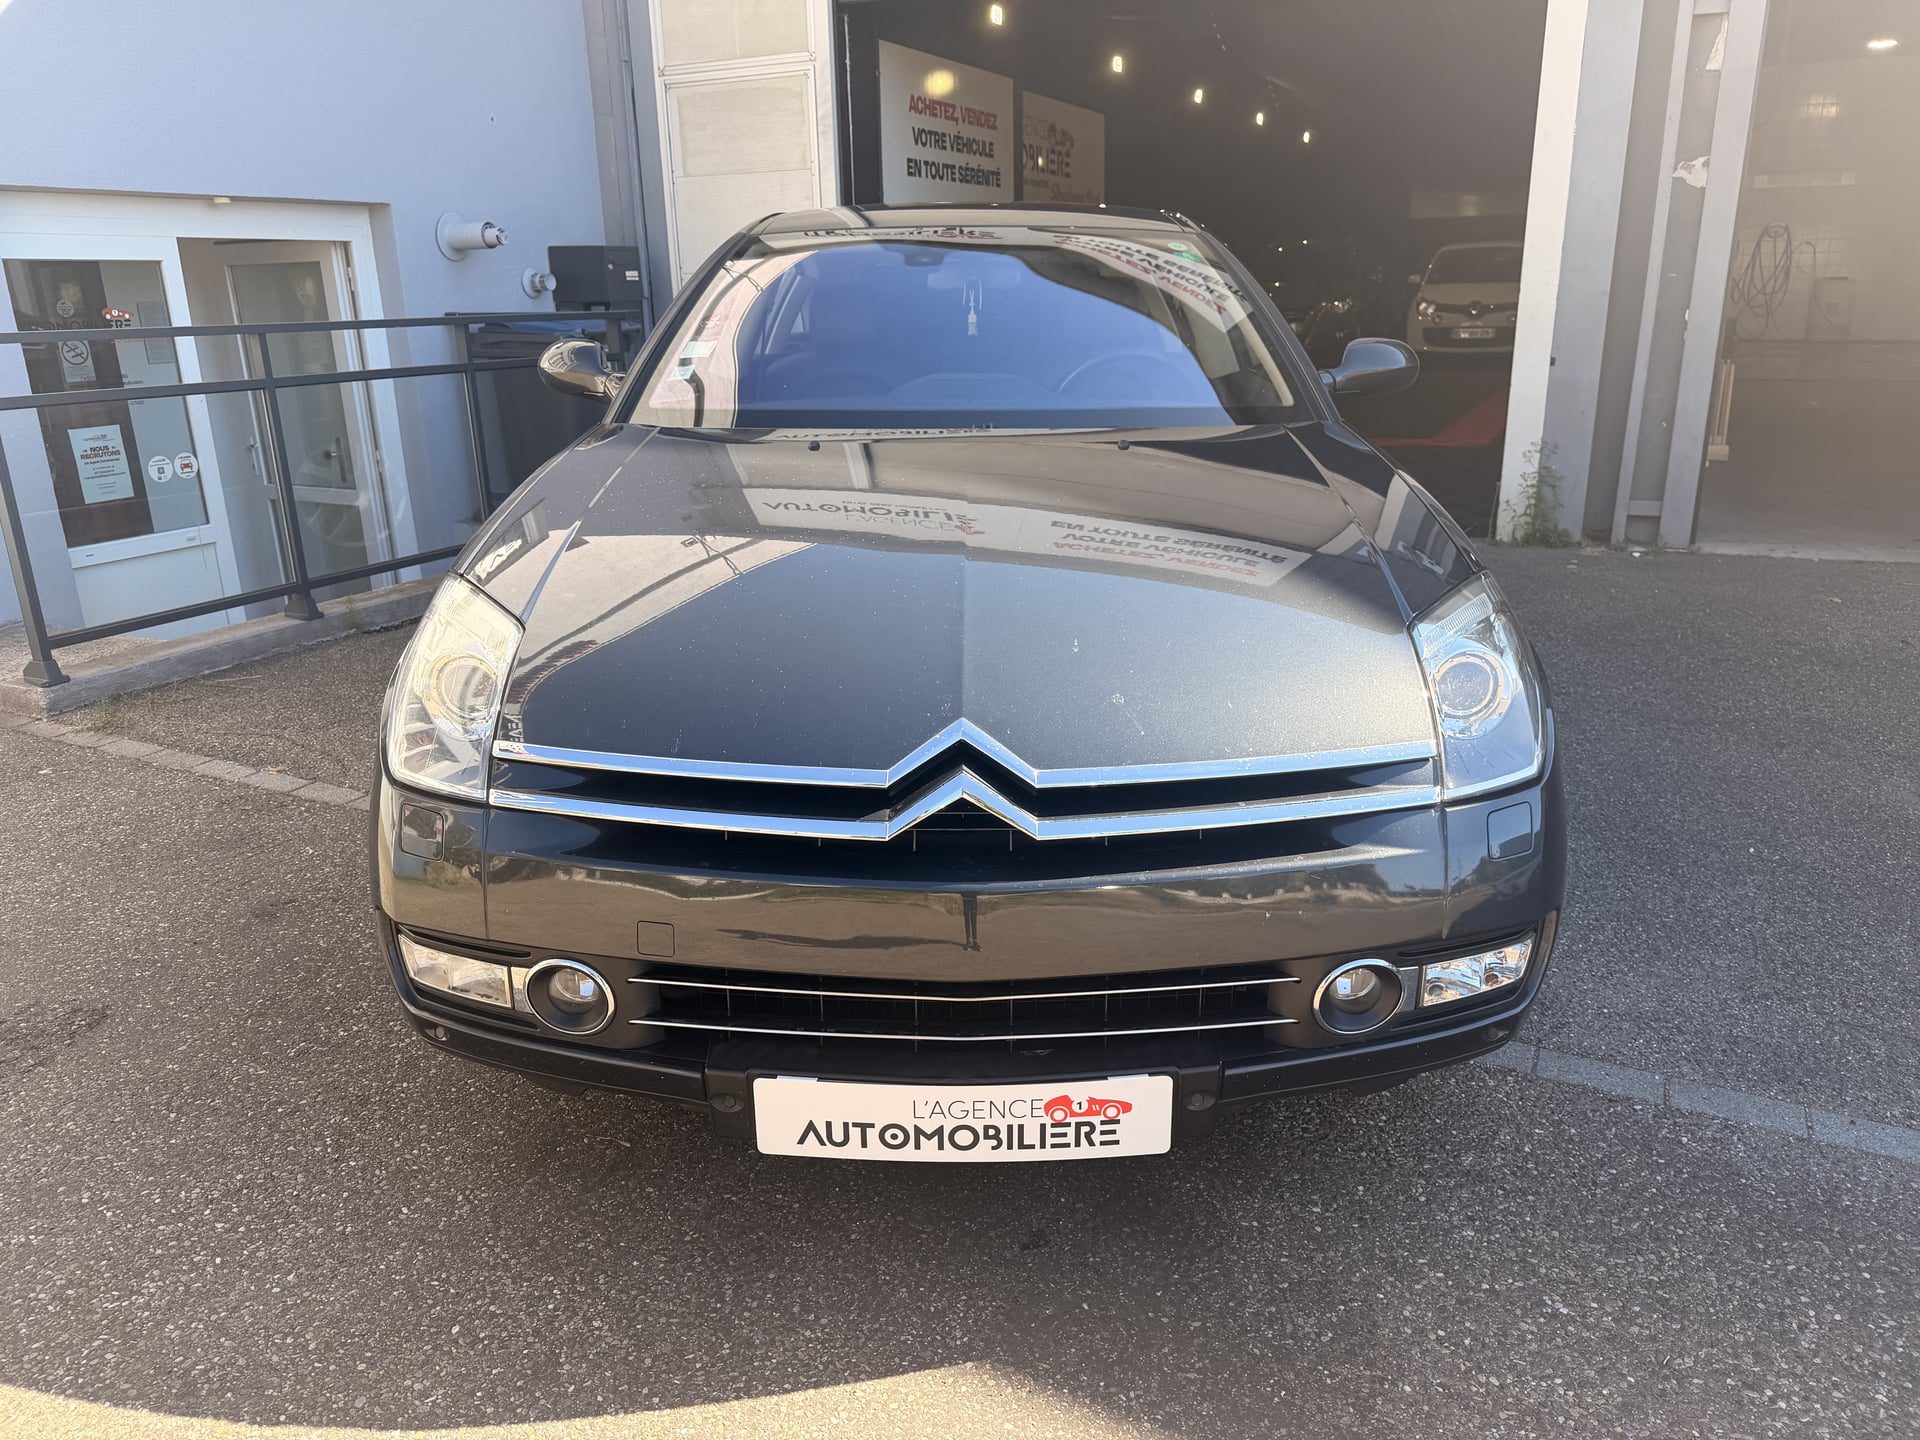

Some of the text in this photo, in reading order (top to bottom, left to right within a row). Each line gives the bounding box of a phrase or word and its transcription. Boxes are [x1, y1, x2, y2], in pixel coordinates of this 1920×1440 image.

[908, 94, 959, 126] ACHETEZ,
[960, 105, 998, 131] VENDEZ
[912, 126, 994, 158] VOTRE VÉHICULE
[907, 158, 922, 177] EN
[923, 159, 957, 182] TOUTE
[957, 162, 1001, 188] SÉRÉNITÉ
[80, 450, 121, 460] RECRUTONS
[89, 445, 110, 453] NOUS
[913, 1098, 1044, 1120] L'AGENCE
